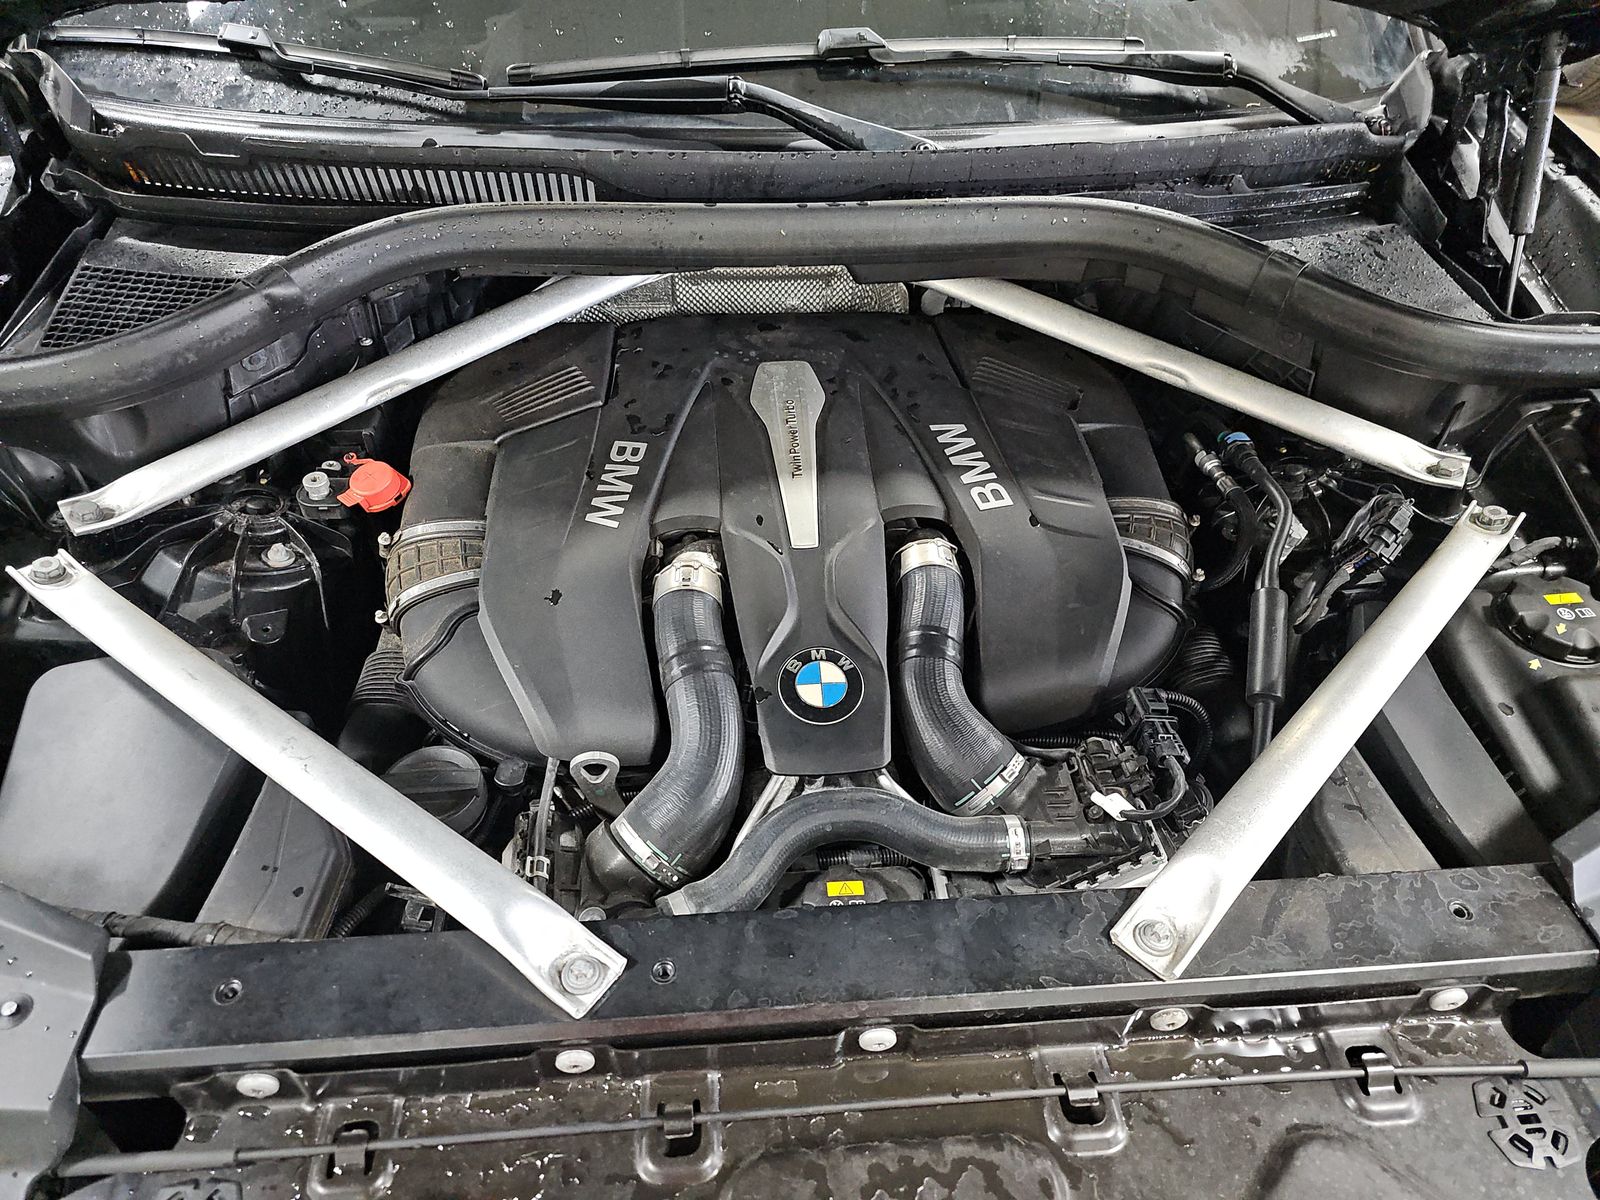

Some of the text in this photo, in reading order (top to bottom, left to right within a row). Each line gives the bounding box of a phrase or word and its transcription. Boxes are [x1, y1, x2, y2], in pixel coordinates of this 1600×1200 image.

[585, 440, 648, 528] BMW
[928, 423, 1014, 511] BMW
[785, 649, 855, 674] BMW
